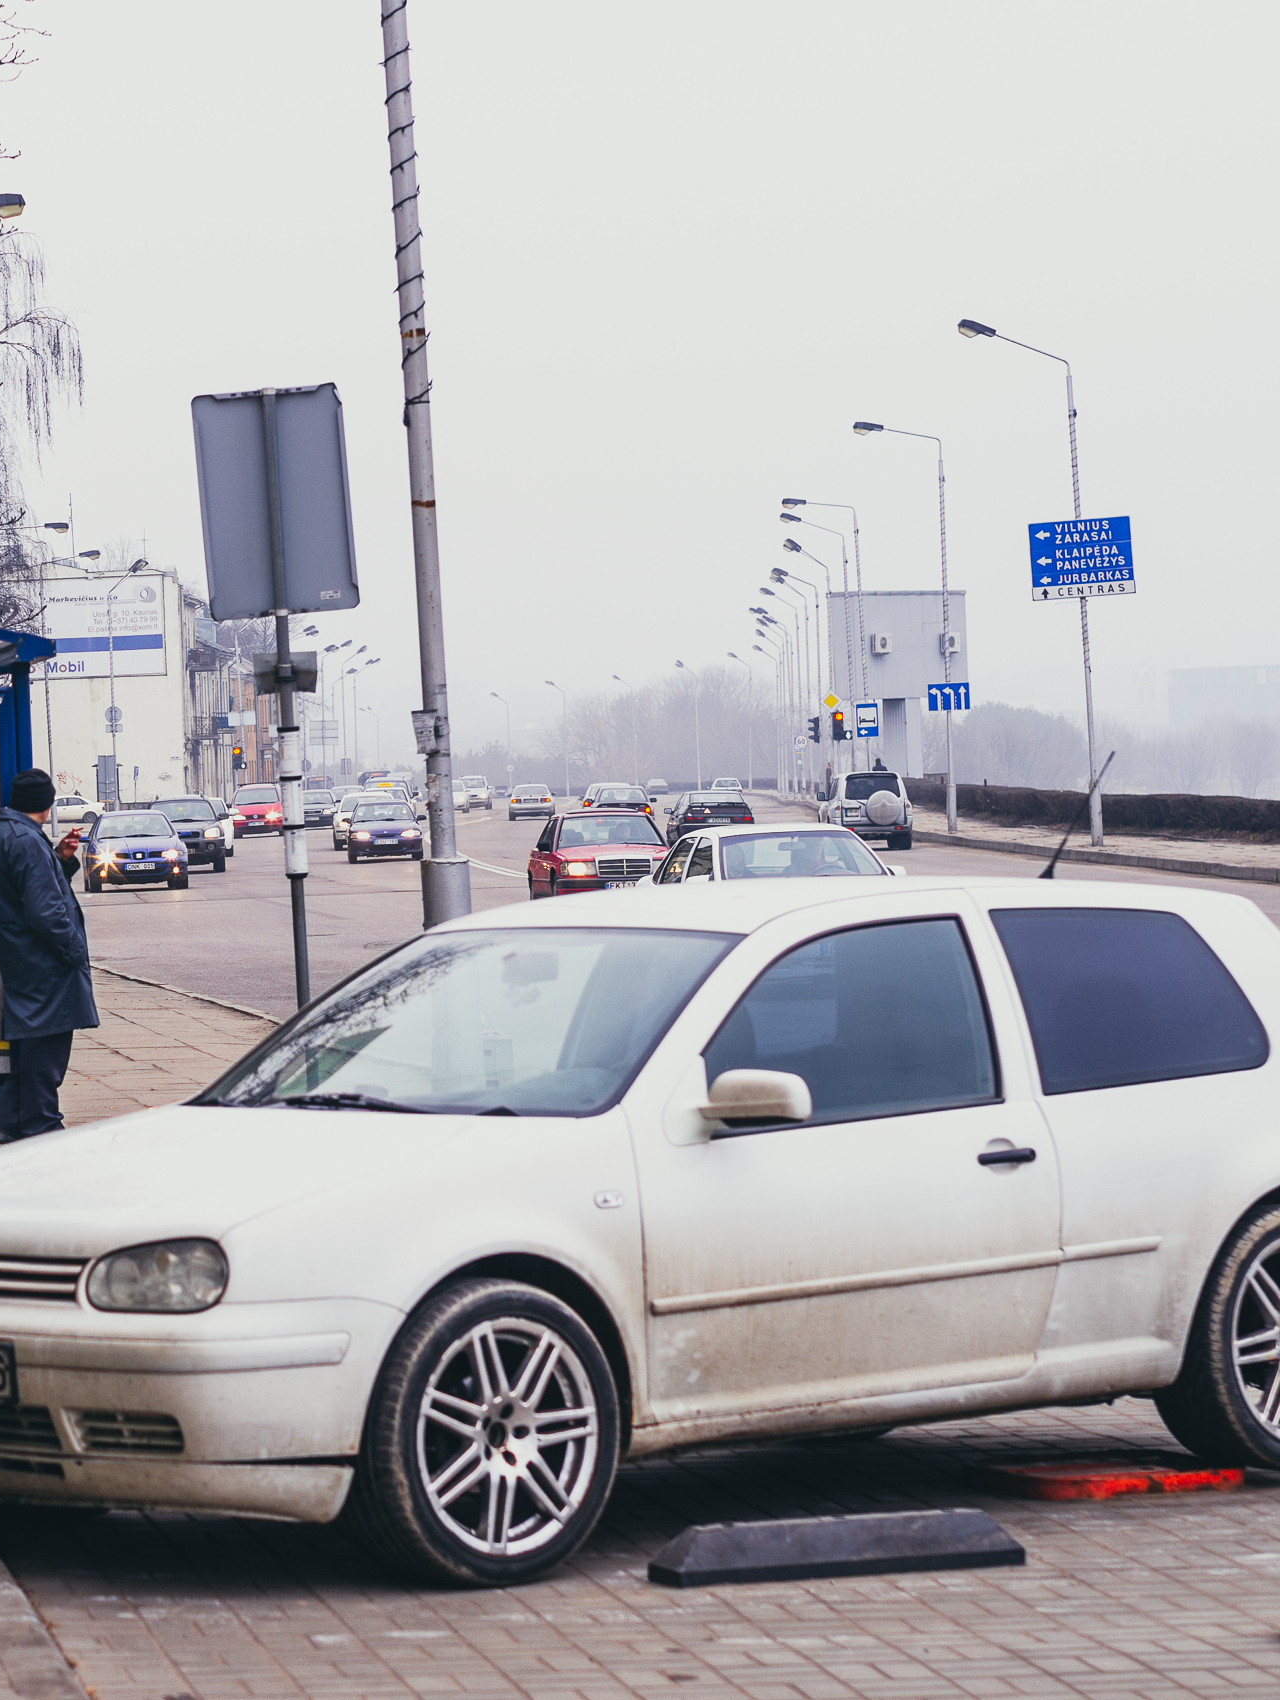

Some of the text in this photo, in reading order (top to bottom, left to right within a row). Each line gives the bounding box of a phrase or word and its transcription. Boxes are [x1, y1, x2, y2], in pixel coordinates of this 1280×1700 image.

[1055, 520, 1109, 534] VILNIUS
[1055, 530, 1112, 544] ZARASAI
[1055, 545, 1119, 559] KLAIPĖDA
[1056, 555, 1126, 570] PANEVĖŽYS
[1057, 569, 1130, 584] JURBARKAS
[1057, 583, 1125, 597] CENTRAS
[42, 594, 97, 603] .Markevičius
[46, 660, 85, 673] Mobil
